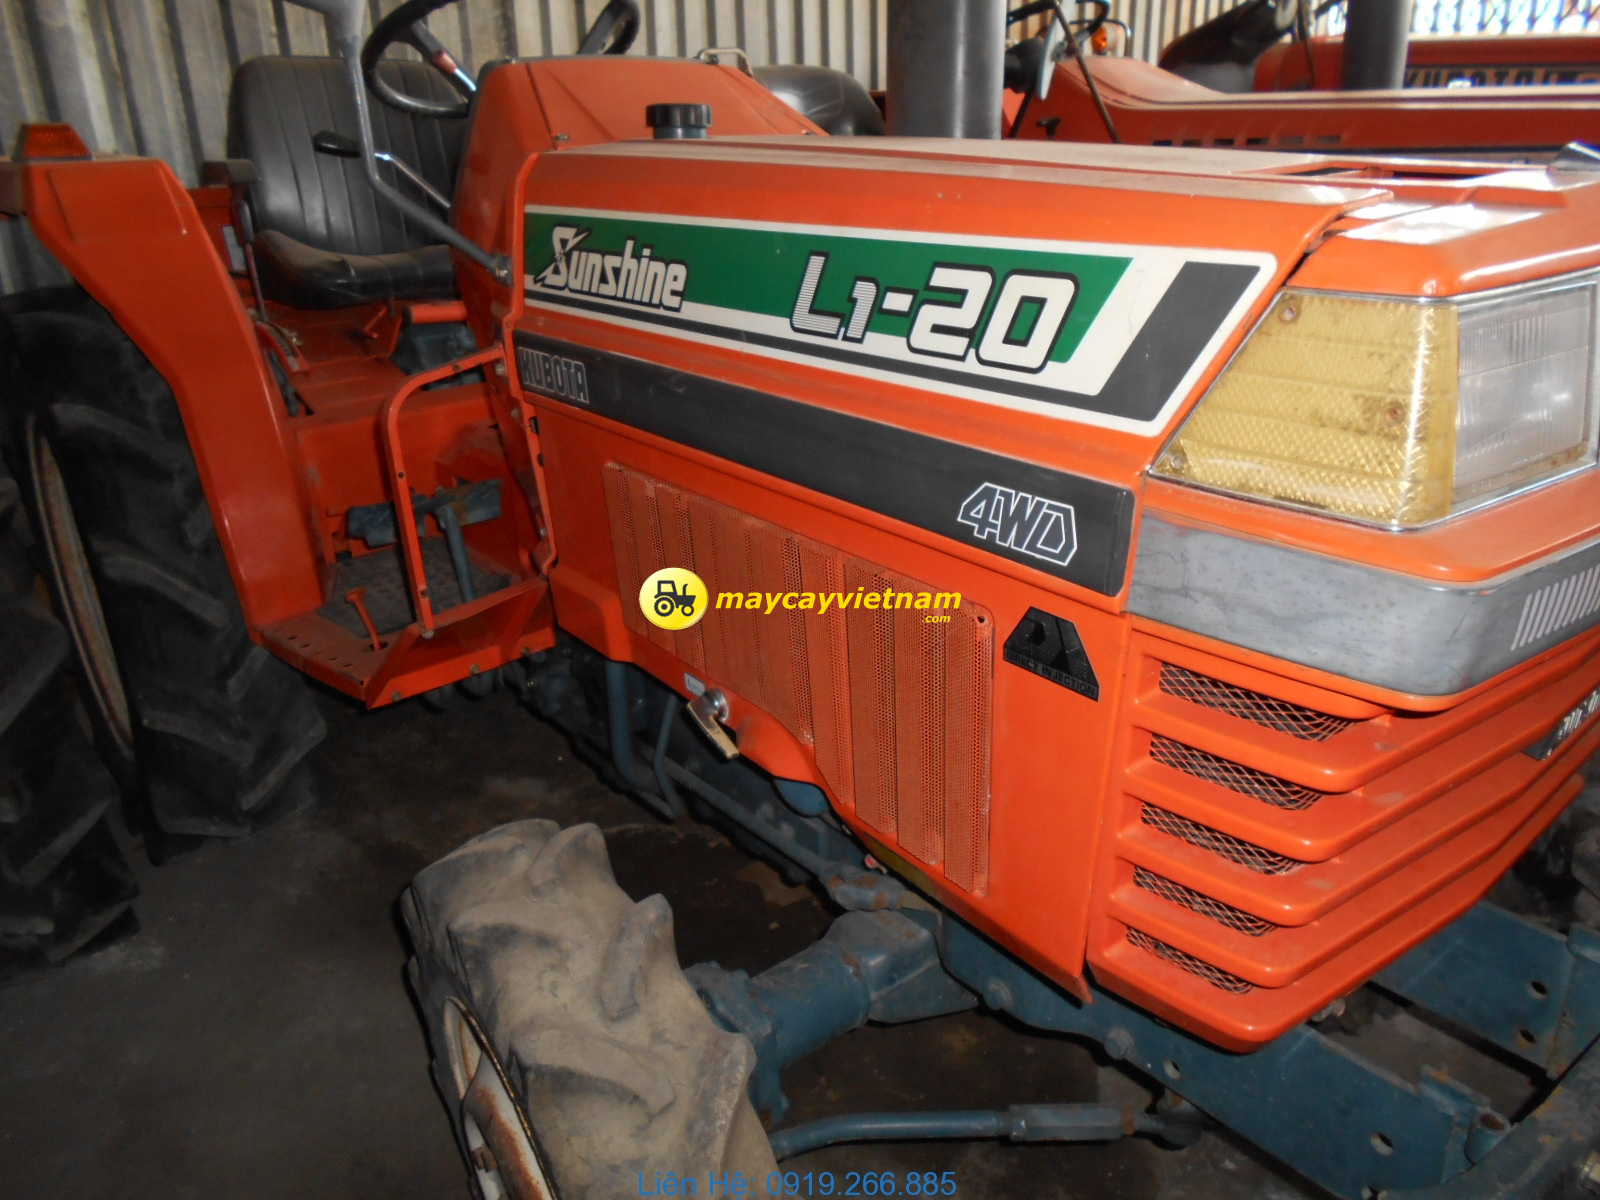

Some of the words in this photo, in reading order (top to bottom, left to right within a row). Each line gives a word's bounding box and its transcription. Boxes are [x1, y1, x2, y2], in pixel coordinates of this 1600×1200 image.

[534, 224, 687, 311] Sunshine
[790, 251, 1080, 374] L1-20
[518, 346, 589, 403] KUBOTA
[957, 481, 1078, 567] 4WD
[1041, 665, 1097, 697] INJECTION
